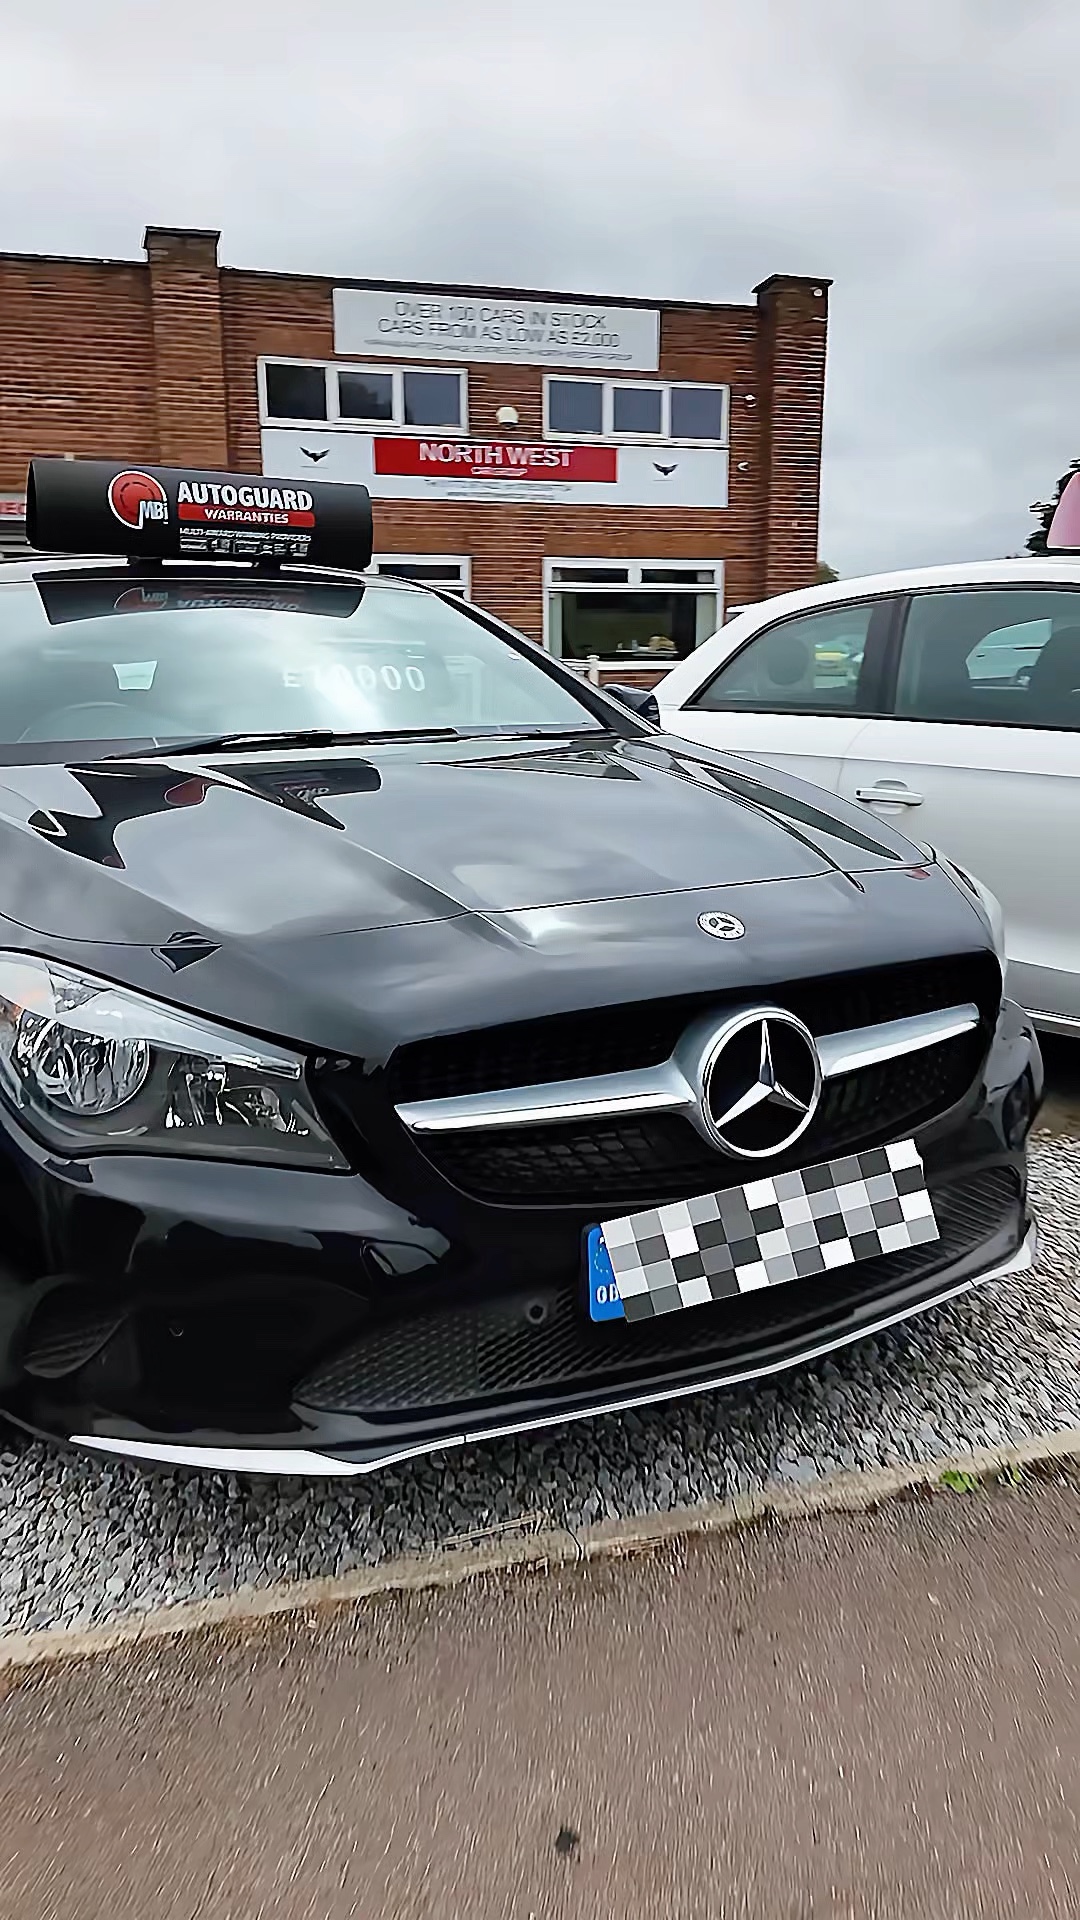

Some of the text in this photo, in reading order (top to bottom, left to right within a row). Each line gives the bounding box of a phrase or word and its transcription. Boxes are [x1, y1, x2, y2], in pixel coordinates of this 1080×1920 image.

[419, 442, 574, 467] NORTH WEST
[177, 481, 313, 511] AUTOGUARD
[204, 508, 289, 524] WARRANTIES
